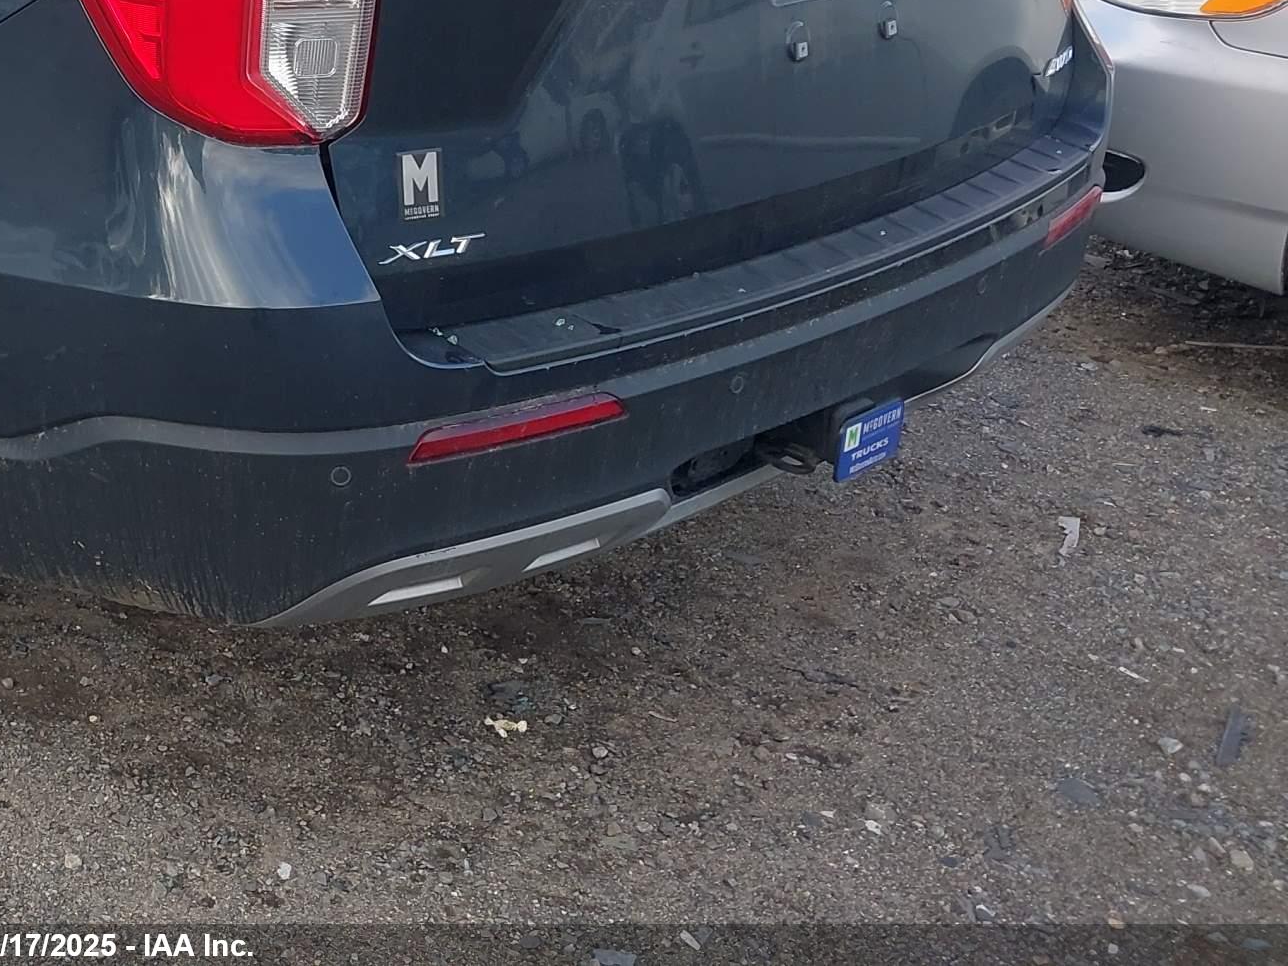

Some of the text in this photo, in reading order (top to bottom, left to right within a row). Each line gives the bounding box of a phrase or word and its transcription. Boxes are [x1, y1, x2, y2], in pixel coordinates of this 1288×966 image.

[402, 151, 439, 206] M
[378, 233, 486, 265] XLT
[851, 437, 889, 461] TRUCKS
